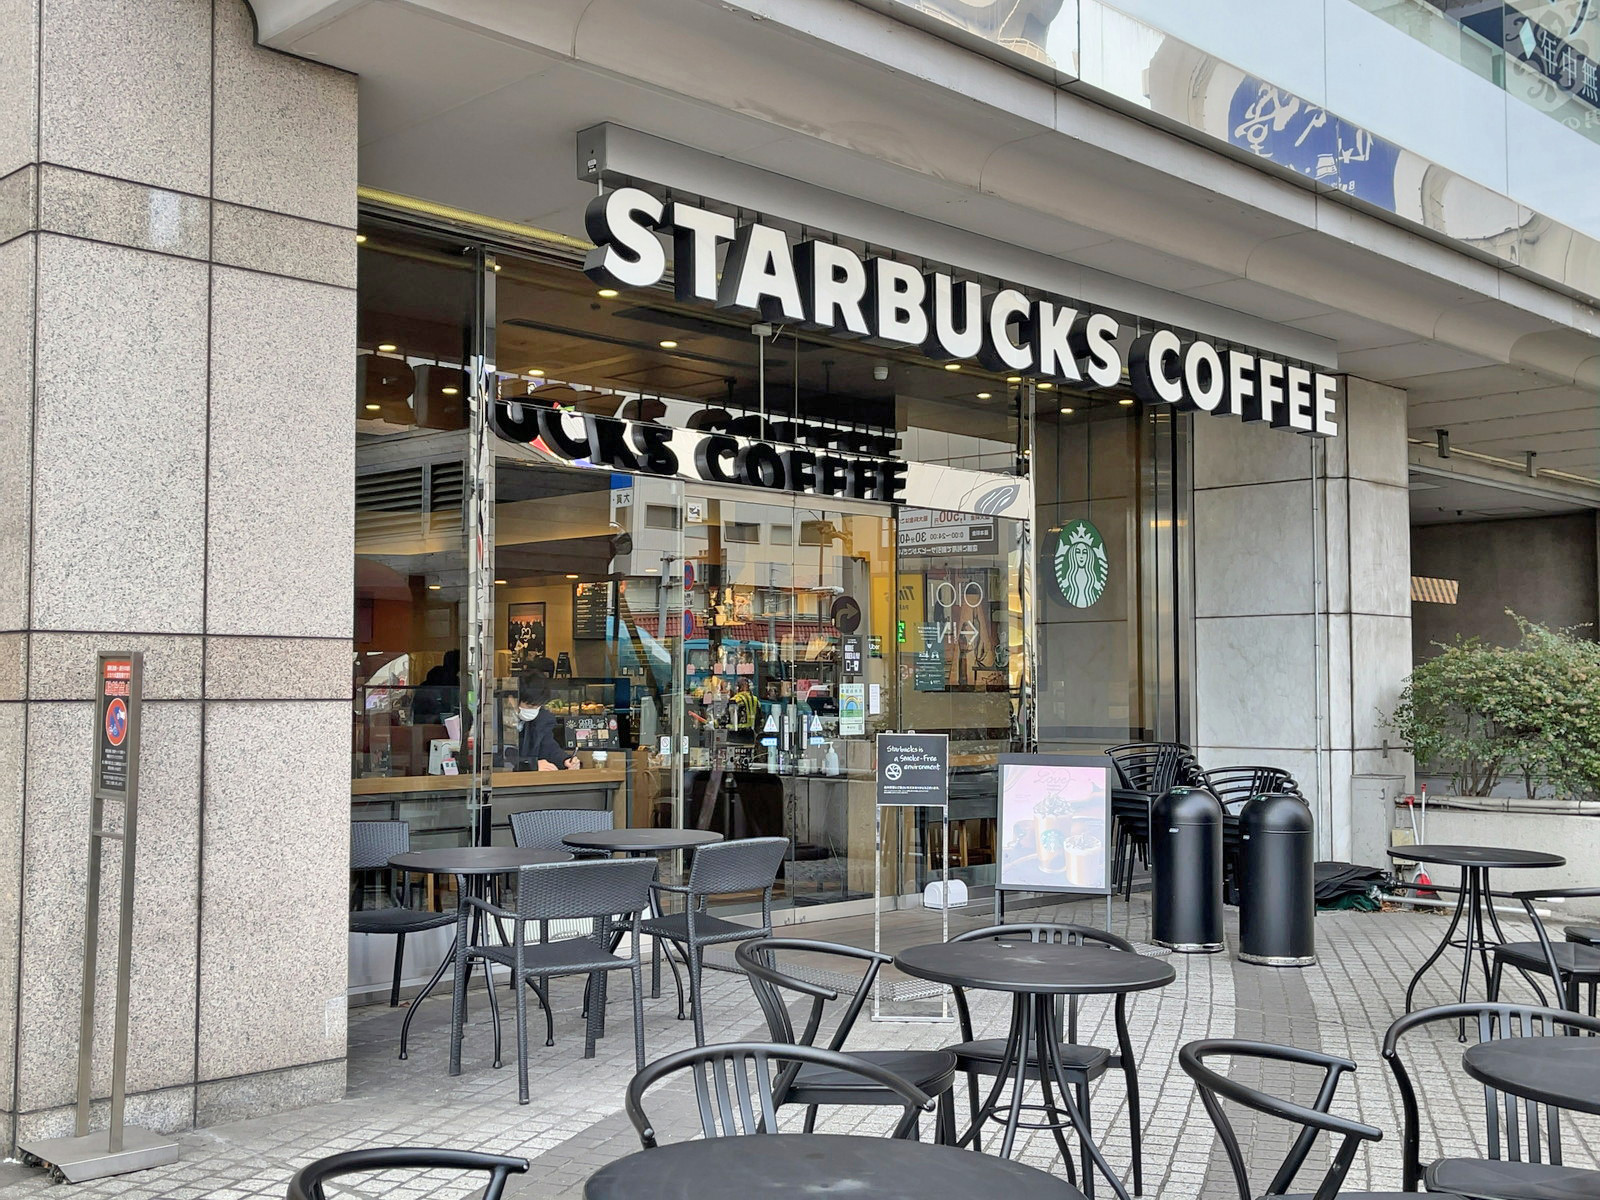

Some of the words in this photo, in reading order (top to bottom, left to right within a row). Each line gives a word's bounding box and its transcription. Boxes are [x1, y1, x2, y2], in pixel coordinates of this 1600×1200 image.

[603, 186, 1122, 388] STARBUCKS
[1148, 329, 1339, 438] COFFEE
[886, 744, 917, 753] Starbucks
[903, 762, 941, 771] environment
